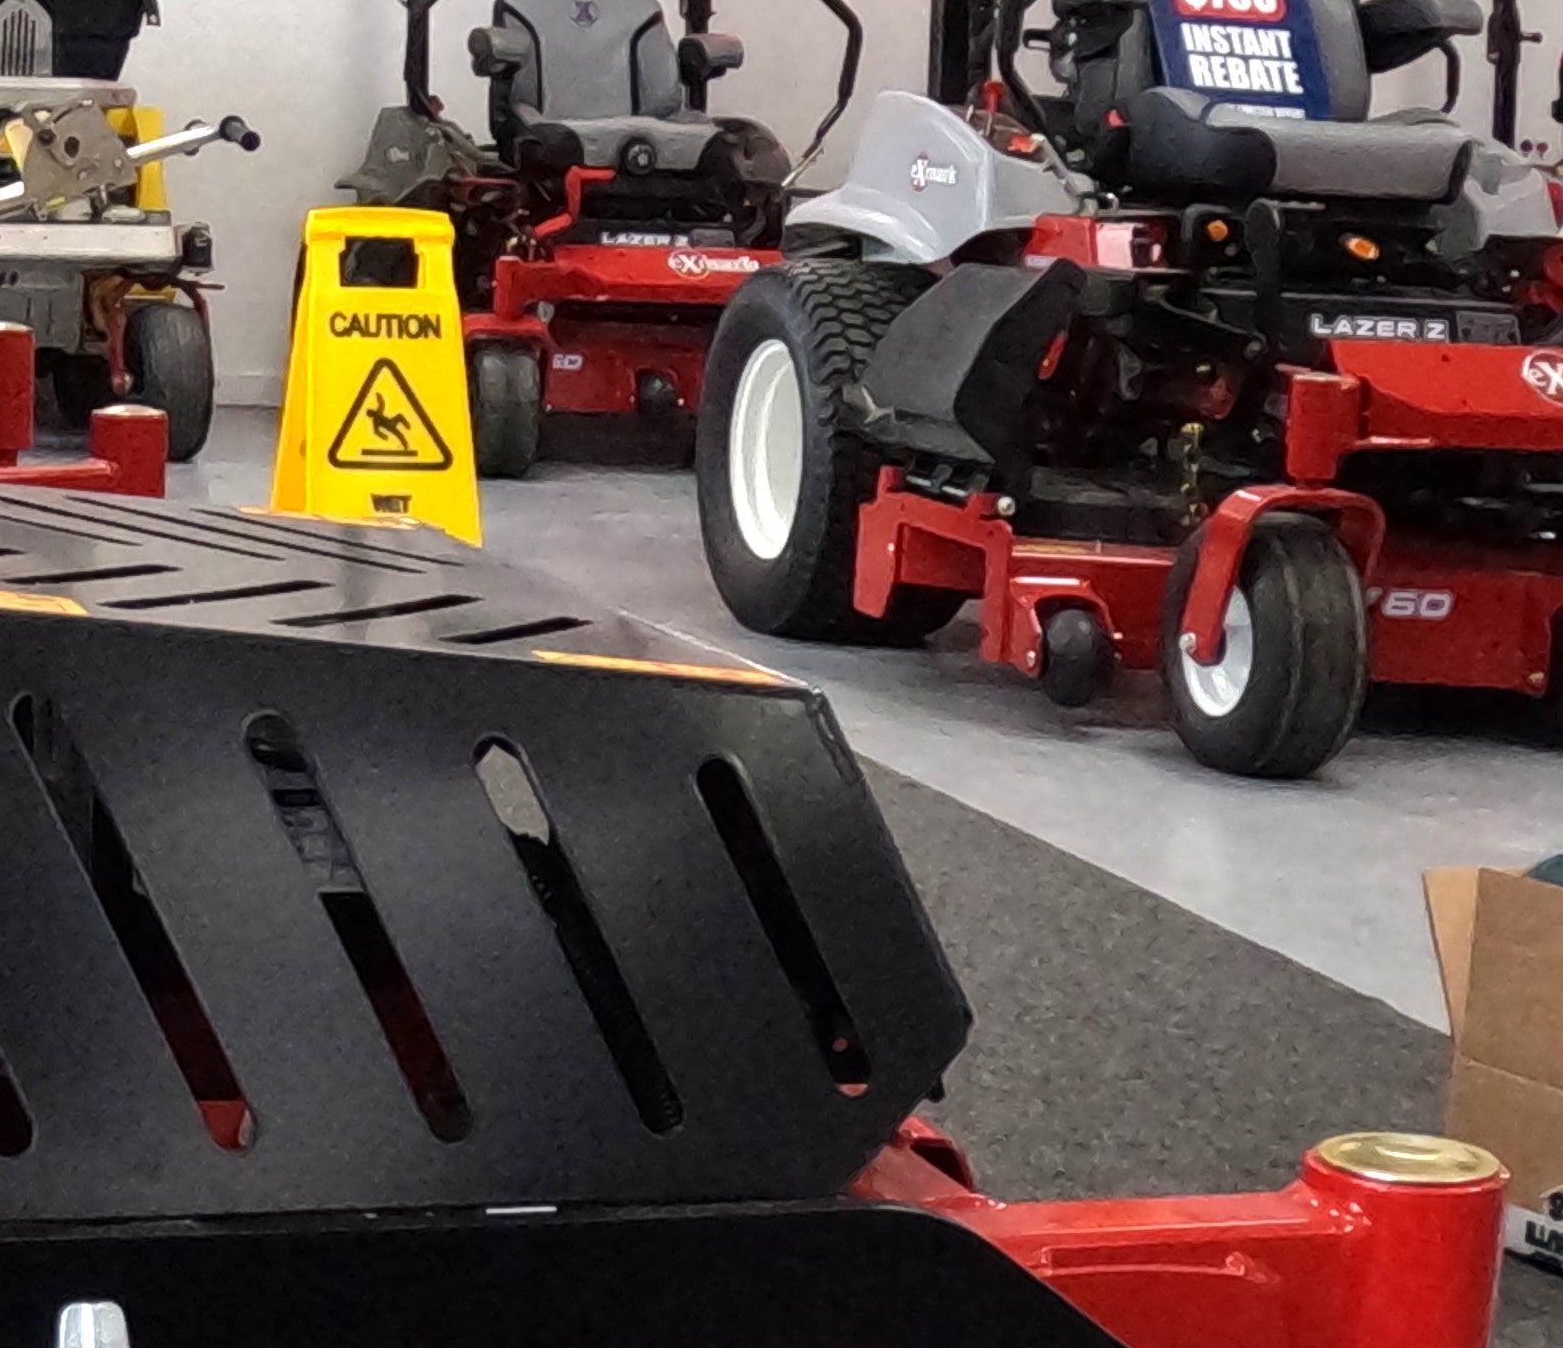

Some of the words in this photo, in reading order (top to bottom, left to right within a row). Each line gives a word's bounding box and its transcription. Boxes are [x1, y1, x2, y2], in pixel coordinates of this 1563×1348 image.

[1180, 22, 1293, 59] INSTANT
[1187, 53, 1305, 95] REBATE
[328, 311, 442, 340] CAUTION
[1309, 313, 1418, 340] LAZER
[1423, 318, 1450, 342] Z
